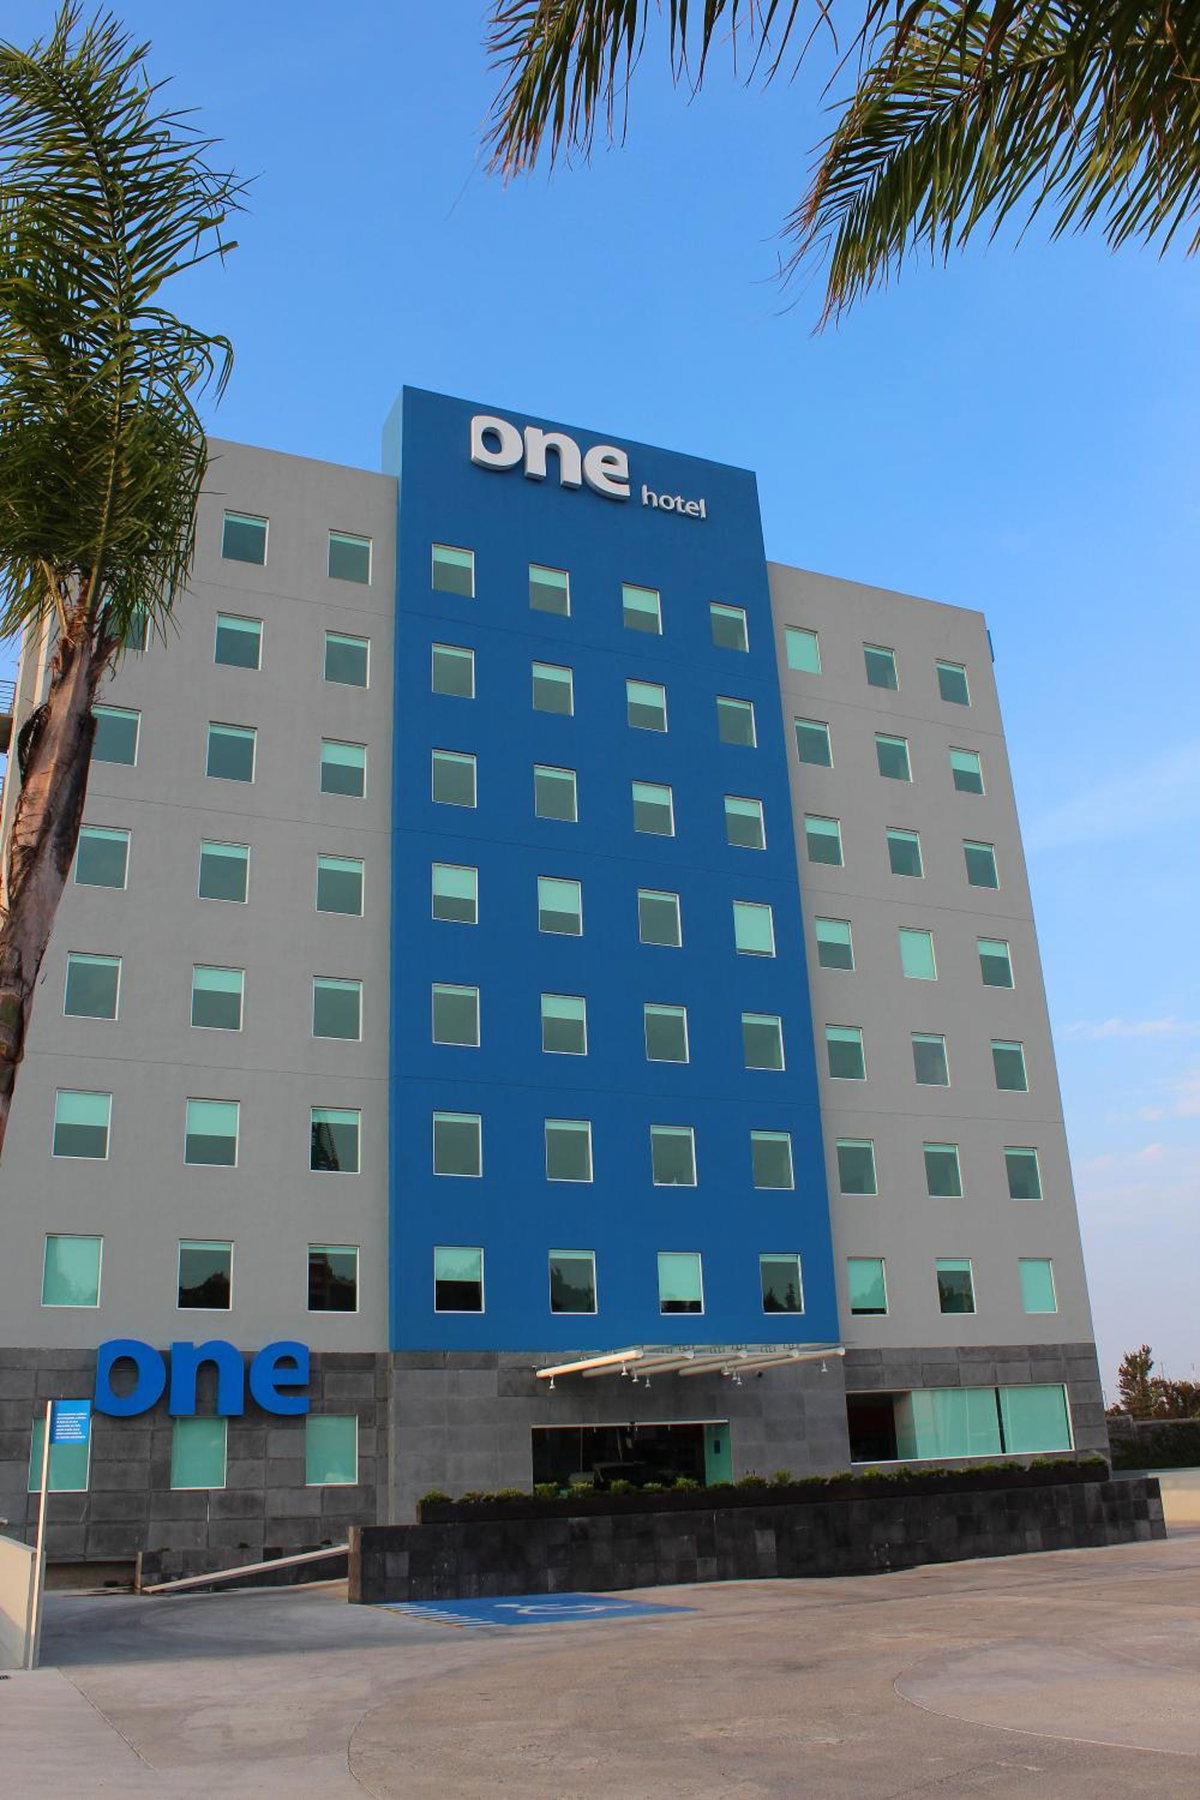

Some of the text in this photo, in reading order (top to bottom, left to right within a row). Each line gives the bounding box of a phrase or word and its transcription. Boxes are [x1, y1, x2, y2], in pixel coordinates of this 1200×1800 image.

[470, 415, 707, 519] one hotel
[95, 1338, 311, 1416] one
